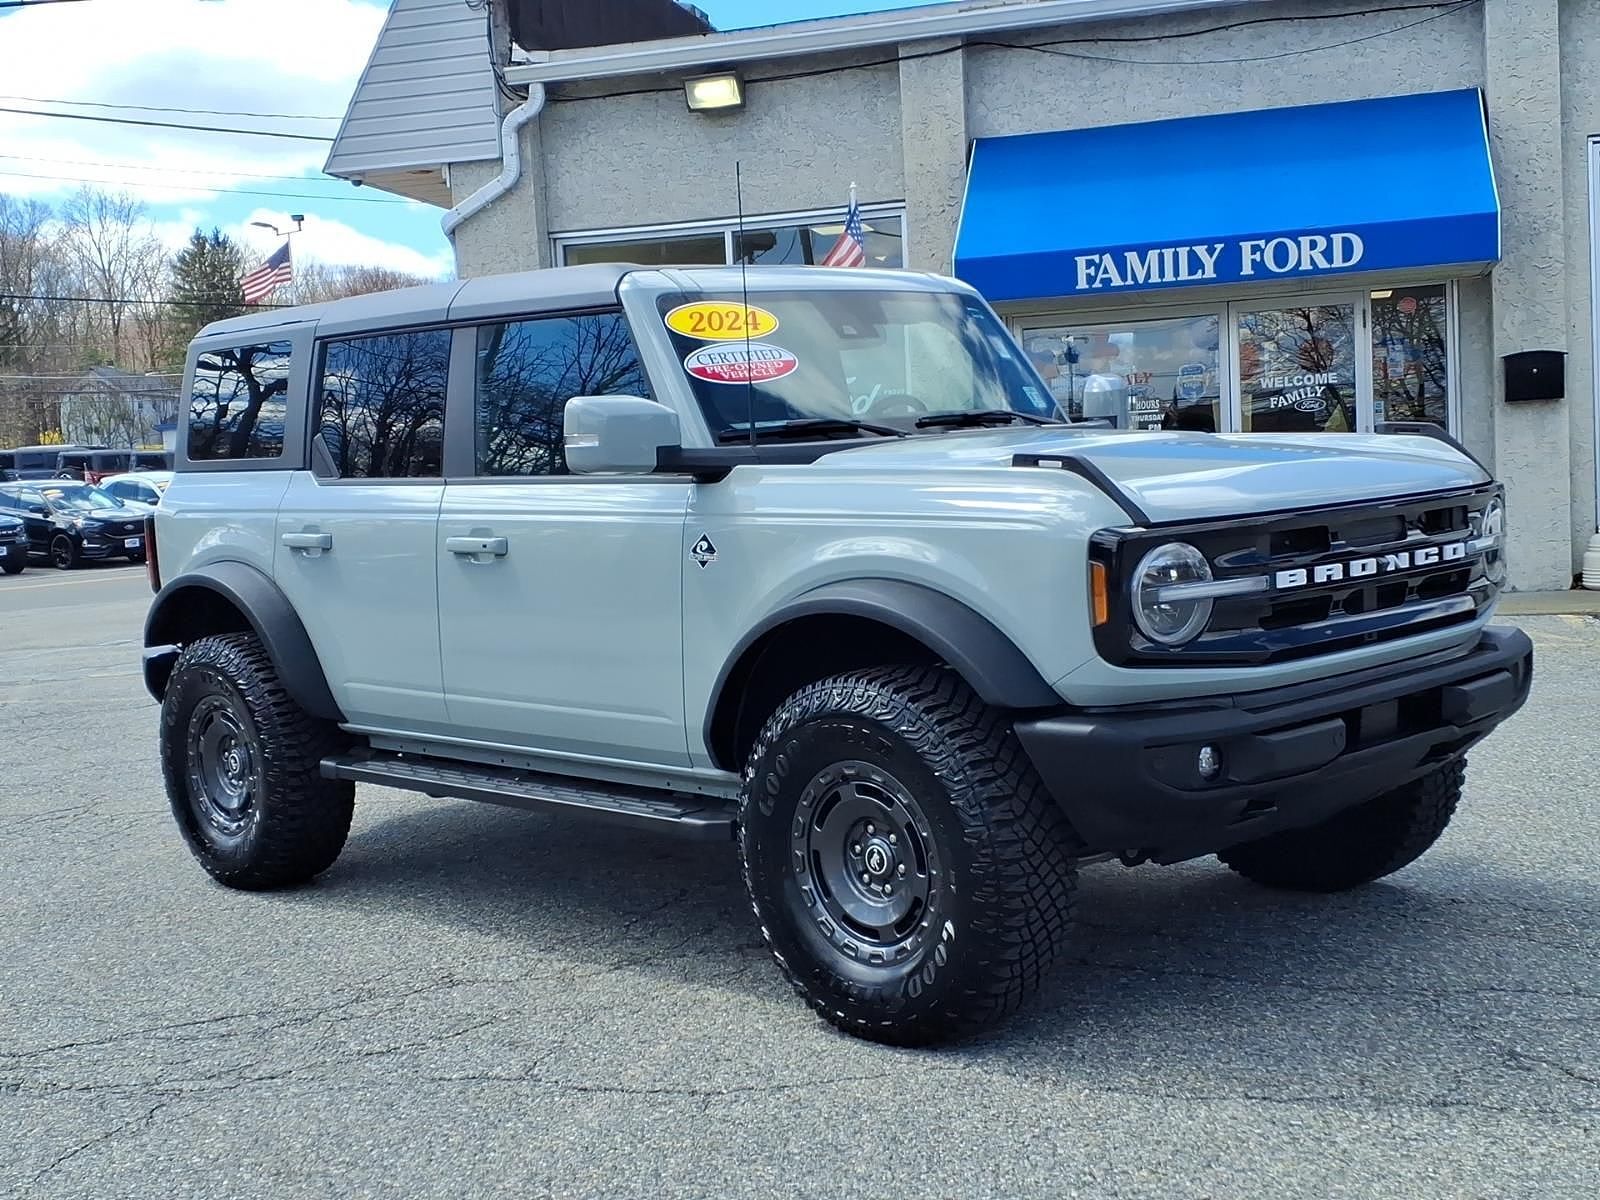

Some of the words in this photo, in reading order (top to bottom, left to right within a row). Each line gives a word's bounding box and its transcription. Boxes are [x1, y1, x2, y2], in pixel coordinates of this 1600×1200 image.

[1074, 243, 1225, 290] FAMILY
[1239, 232, 1365, 276] FORD
[689, 310, 761, 333] 2024
[696, 349, 783, 366] CERTIFIED
[704, 361, 784, 375] PRE-OWNED
[1260, 372, 1338, 389] WELCOME
[1270, 385, 1327, 409] FAMILY
[1275, 542, 1466, 589] BRONCO
